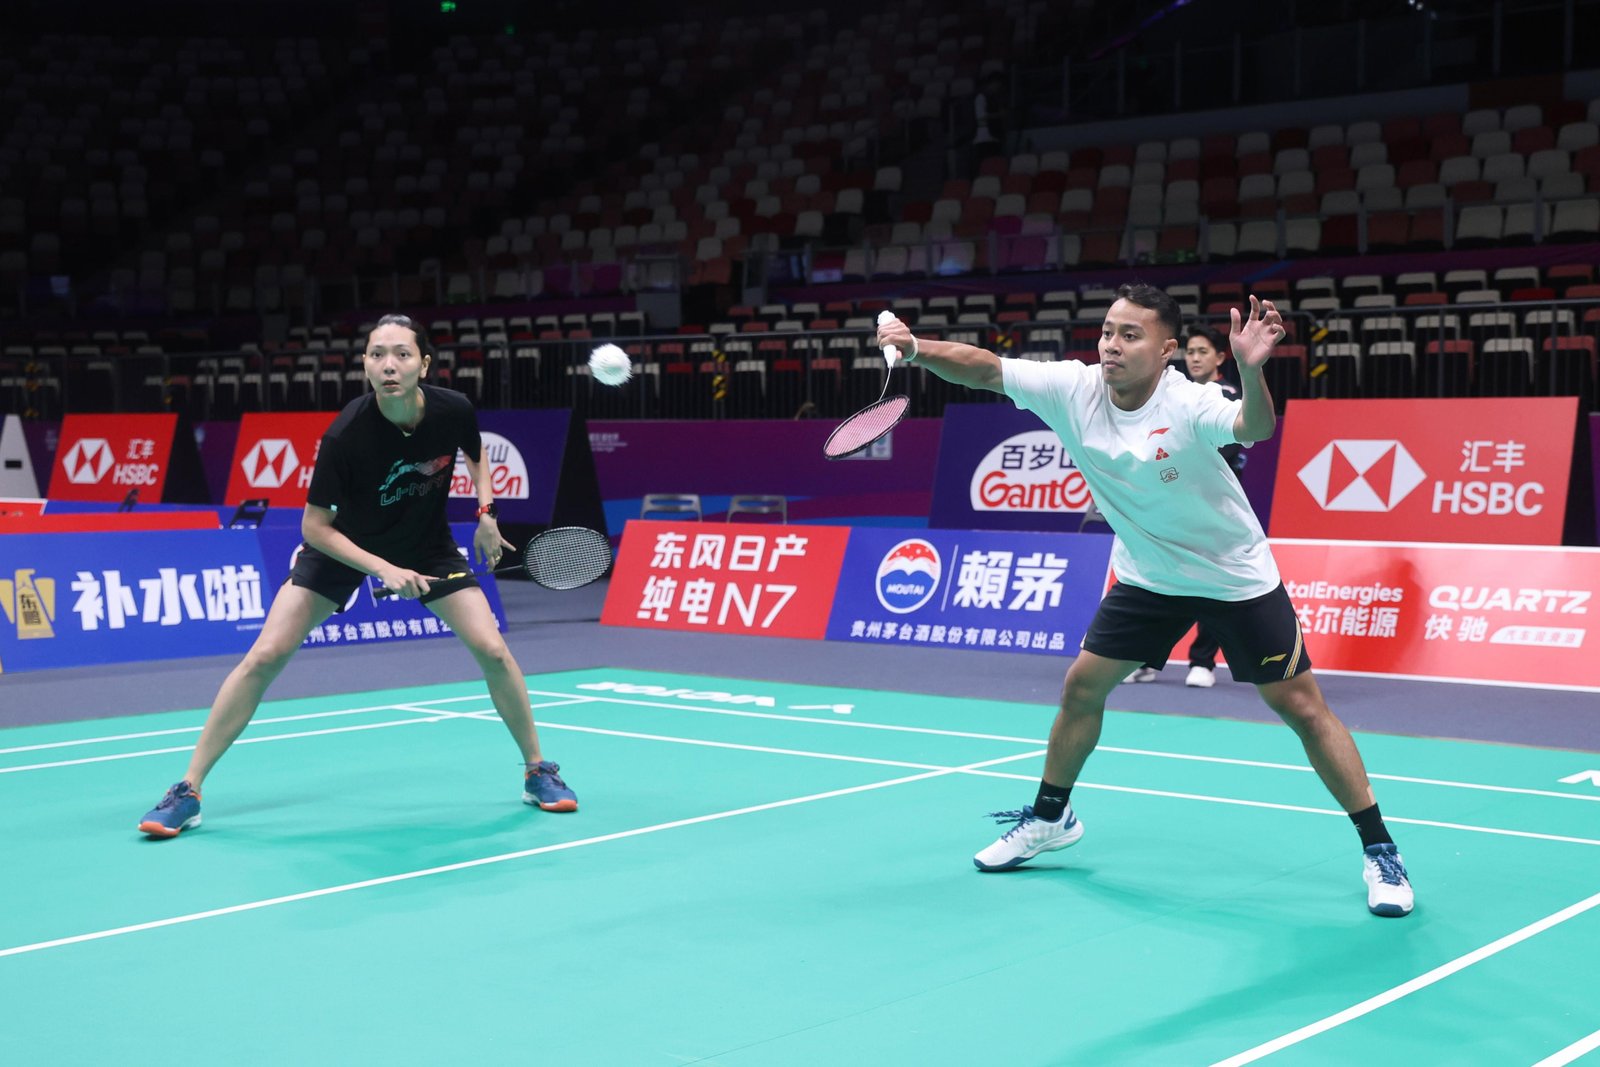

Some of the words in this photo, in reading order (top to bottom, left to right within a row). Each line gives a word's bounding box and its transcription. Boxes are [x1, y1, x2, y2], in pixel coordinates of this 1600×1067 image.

[1459, 440, 1526, 473] 汇丰
[112, 463, 159, 485] HSBC
[1431, 481, 1545, 516] HSBC
[650, 532, 808, 572] 东风日产
[71, 565, 265, 631] 补水啦
[636, 575, 797, 628] 纯电N7
[886, 583, 925, 596] MOUTAI
[1286, 580, 1404, 606] talEnergies
[1428, 585, 1592, 613] QUARTZ
[850, 619, 1065, 650] 贵州茅台酒股份有限公司出品
[1294, 603, 1400, 638] 达尔能源
[1424, 613, 1489, 643] 快驰
